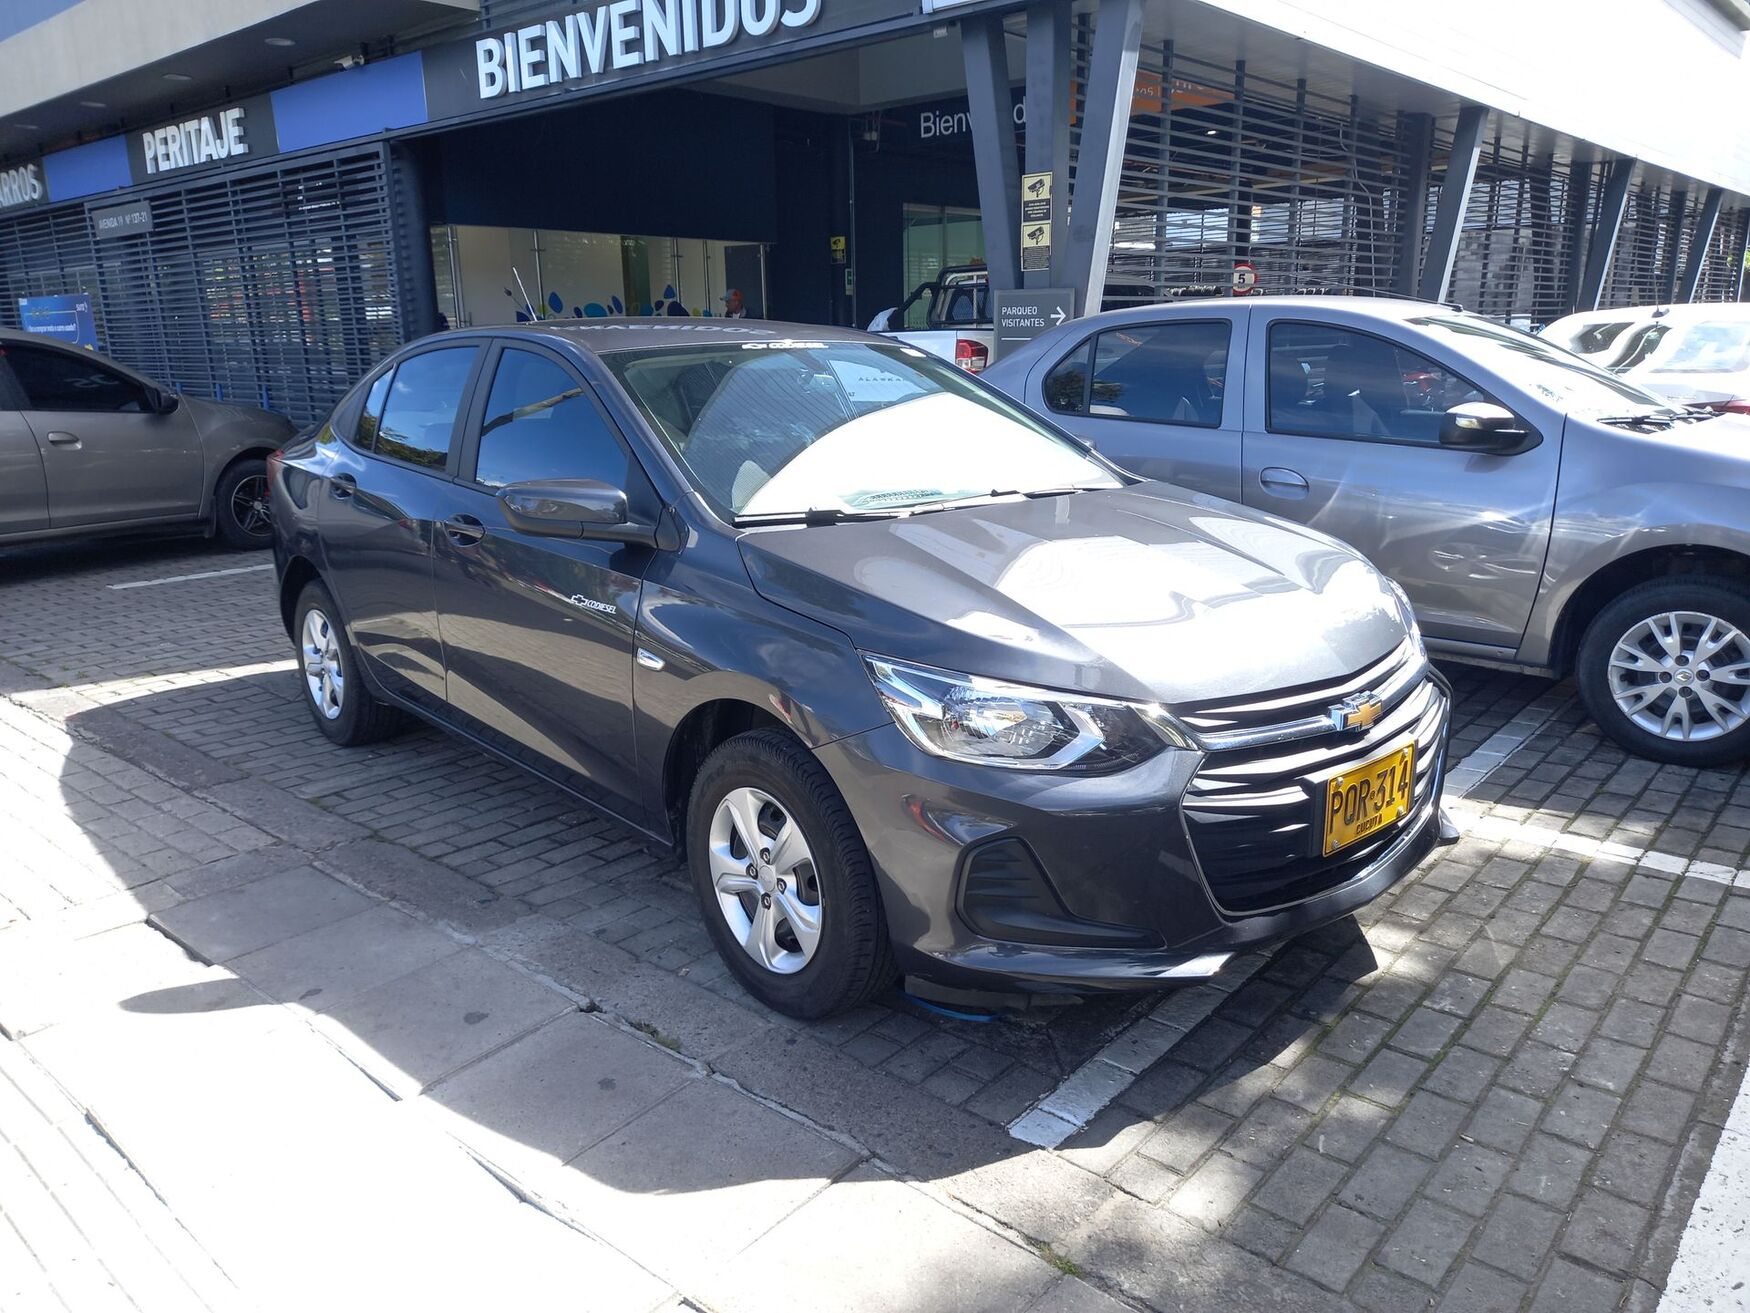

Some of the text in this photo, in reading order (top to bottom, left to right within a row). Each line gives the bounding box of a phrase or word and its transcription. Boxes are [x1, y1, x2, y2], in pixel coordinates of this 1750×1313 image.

[143, 107, 249, 174] PERITAJE
[1238, 273, 1246, 285] 5
[1001, 306, 1038, 315] PARQUEO
[1001, 318, 1045, 327] VISITANTES
[588, 600, 616, 614] CODIESEL
